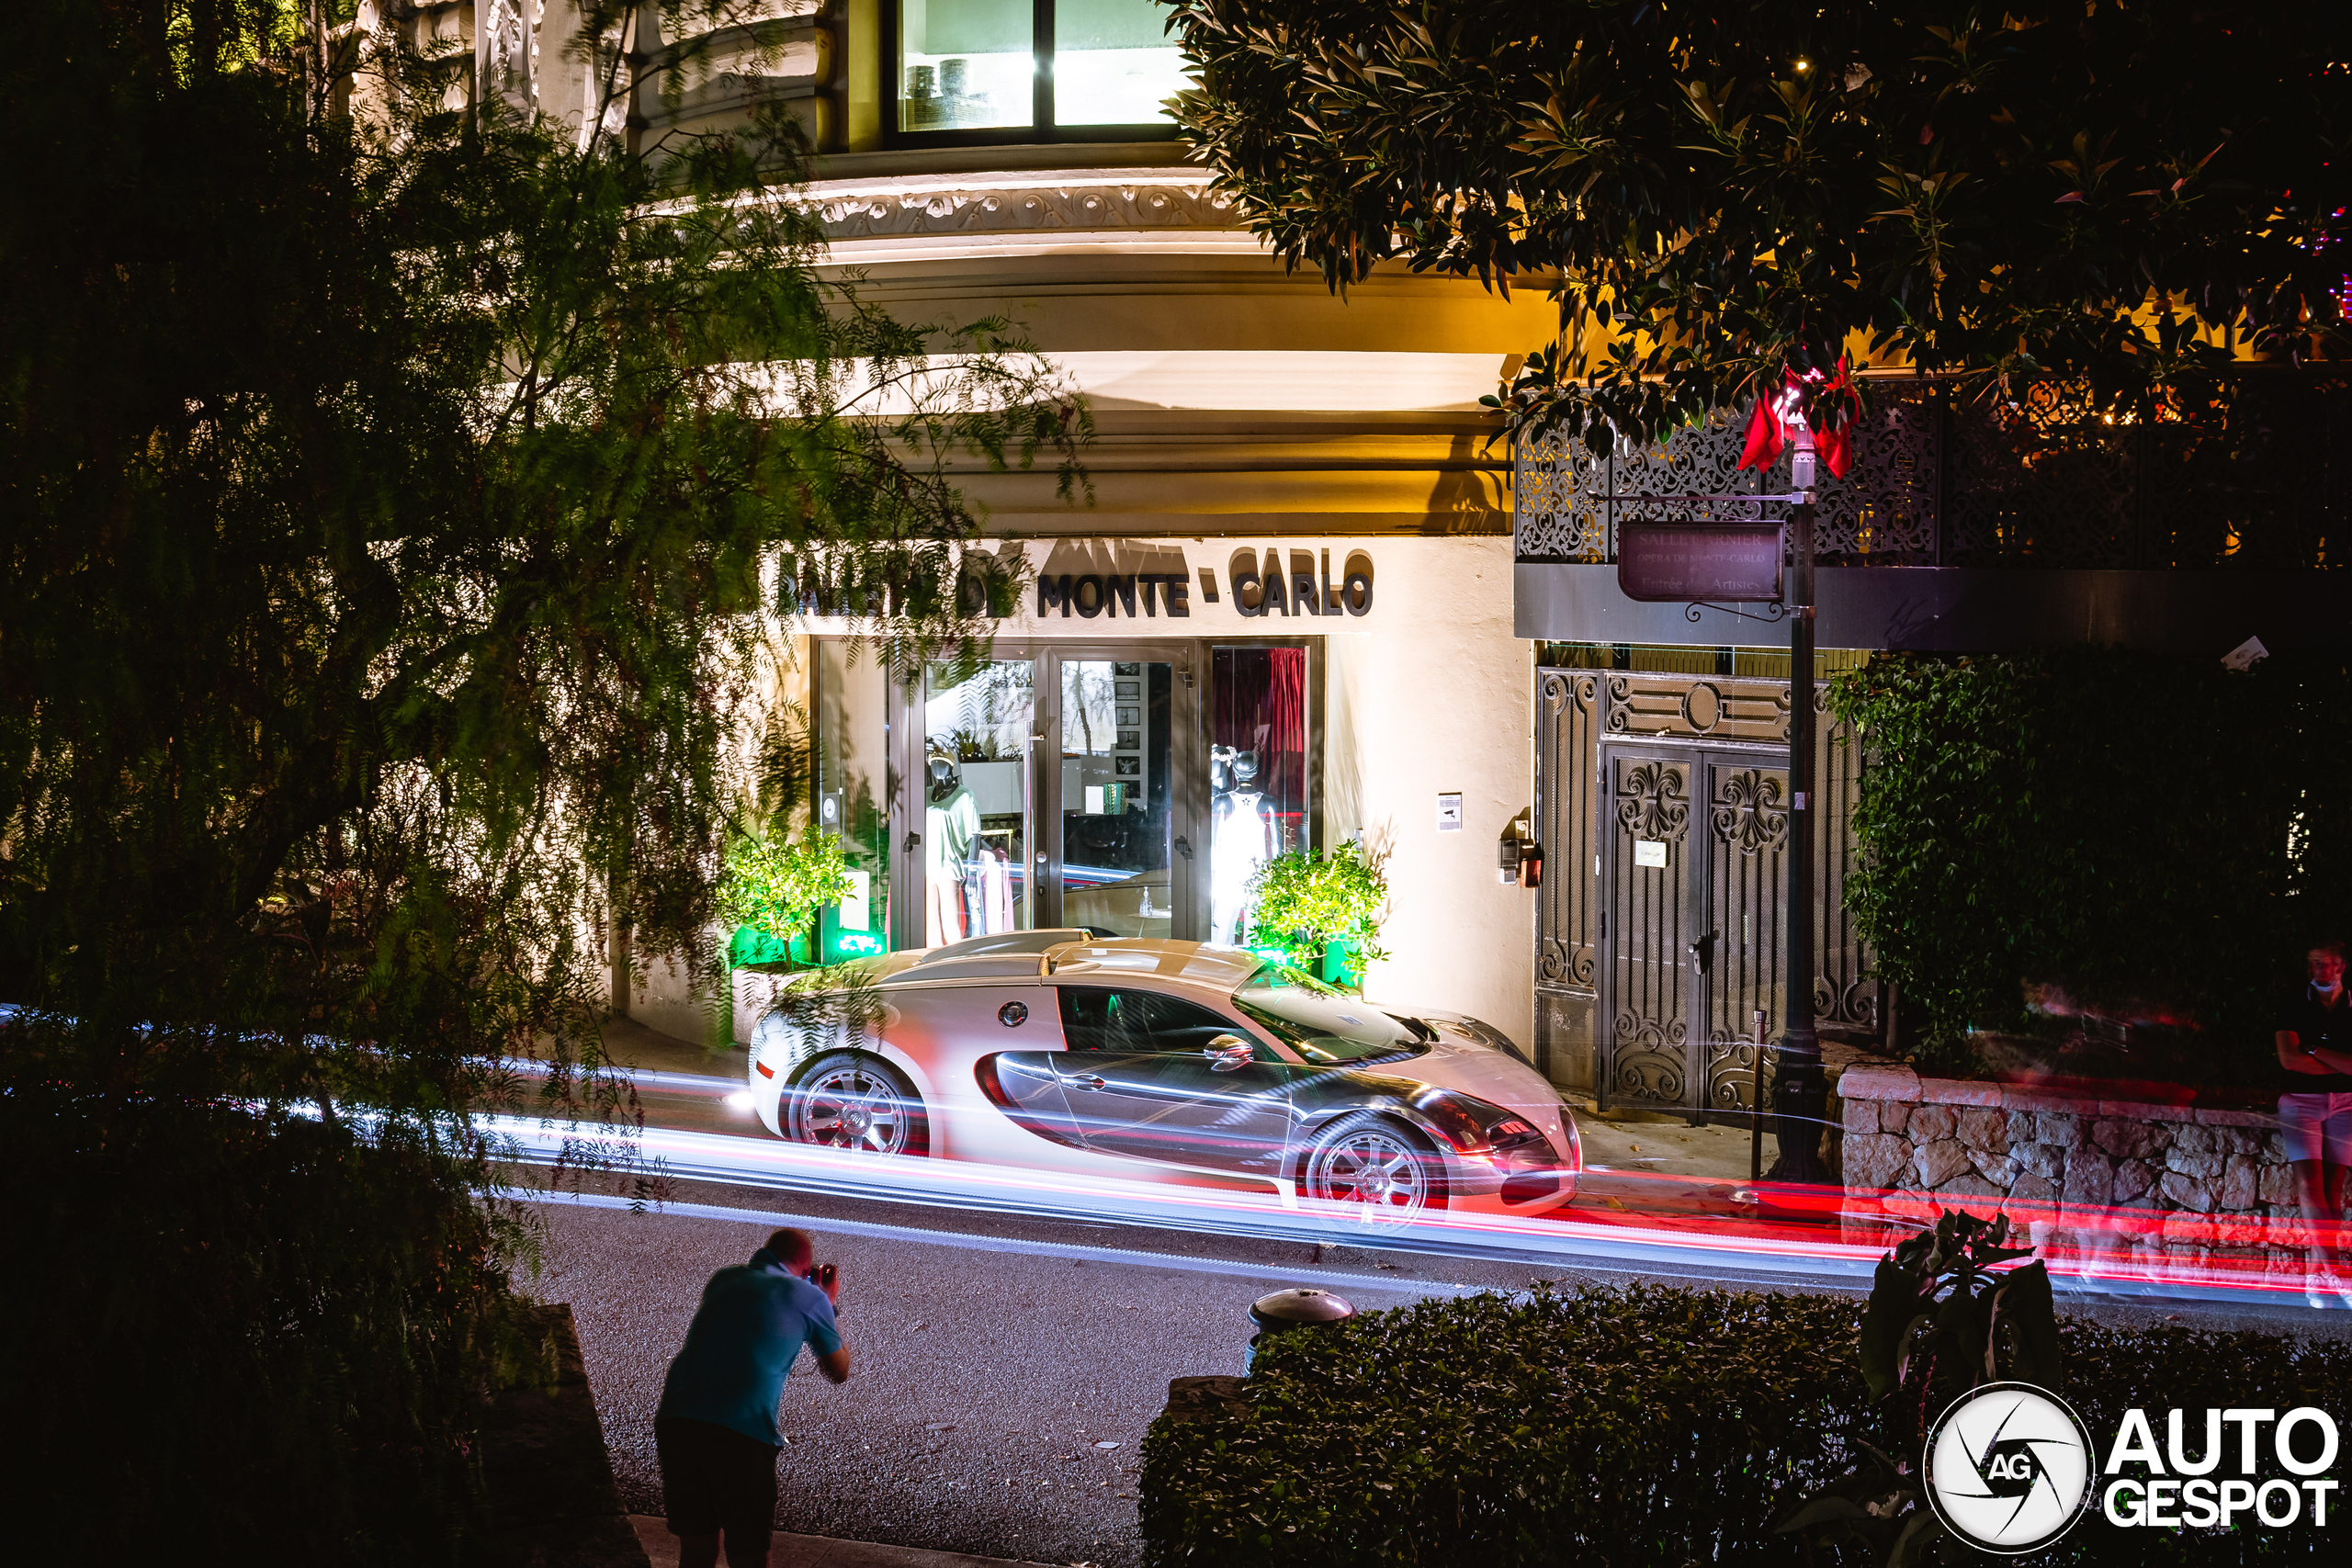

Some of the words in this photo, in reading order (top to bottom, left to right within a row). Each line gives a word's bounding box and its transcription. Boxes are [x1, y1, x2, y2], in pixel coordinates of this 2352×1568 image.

[1639, 534, 1688, 546] SALLE
[1037, 573, 1190, 618] MONTE
[1233, 573, 1373, 617] CARLO
